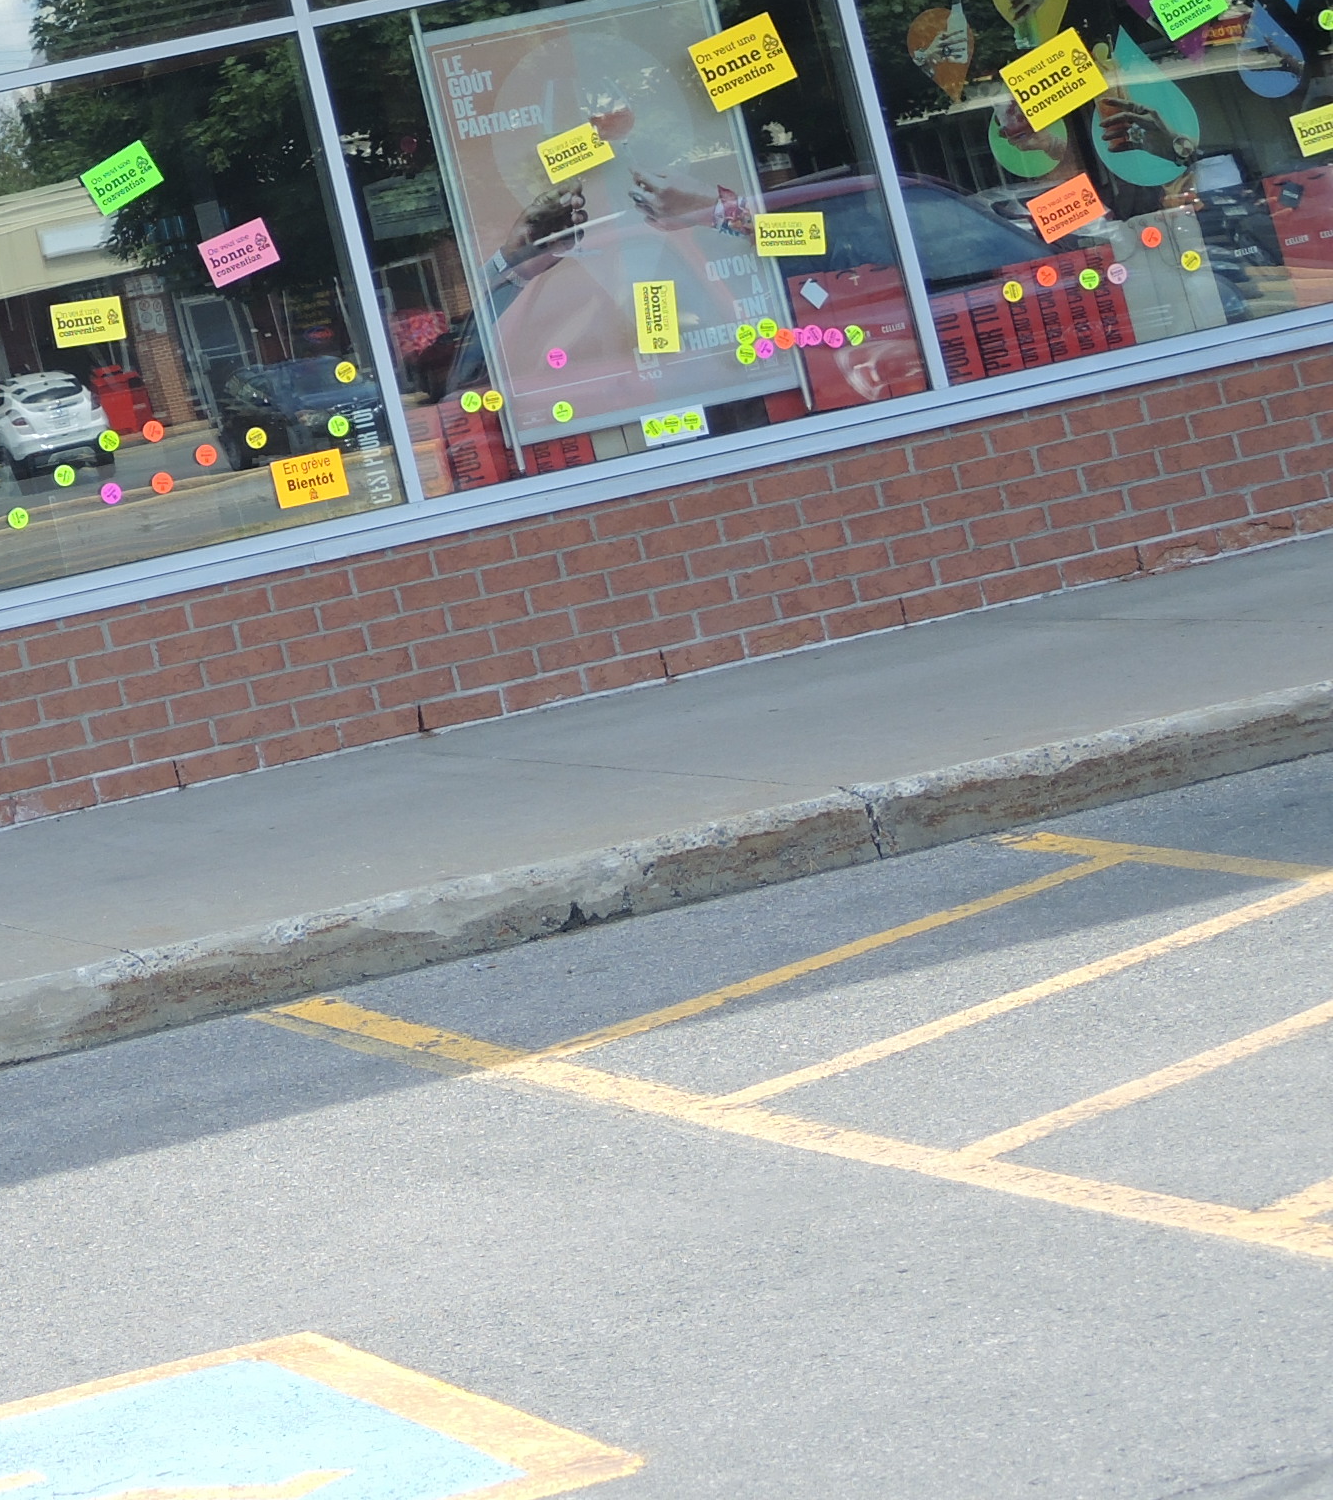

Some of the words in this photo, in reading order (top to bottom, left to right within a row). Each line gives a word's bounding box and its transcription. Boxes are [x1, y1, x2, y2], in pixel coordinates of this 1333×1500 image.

[1170, 4, 1212, 31] convention
[696, 53, 713, 65] On
[713, 42, 735, 57] veut
[737, 34, 756, 47] une
[766, 48, 784, 59] CSN
[442, 54, 465, 78] LE
[701, 48, 762, 83] bonne
[1008, 74, 1024, 86] On
[1024, 60, 1045, 76] veut
[1046, 50, 1065, 64] une
[1077, 61, 1093, 73] CSN
[448, 69, 493, 98] GOÛT
[710, 63, 775, 97] convention
[1015, 65, 1072, 103] bonne
[452, 96, 477, 119] DE
[1026, 77, 1086, 117] convention
[457, 104, 544, 140] PARTAGER
[1298, 121, 1333, 138] bonn
[544, 141, 588, 166] bonne
[94, 168, 136, 197] bonne
[103, 176, 145, 205] convention
[1039, 200, 1082, 226] bonne
[1046, 209, 1090, 234] convention
[759, 227, 803, 239] bonne
[210, 244, 254, 269] bonne
[217, 253, 262, 277] convention
[705, 254, 759, 282] QU'ON
[751, 275, 764, 294] A
[650, 285, 663, 332] bonne
[733, 295, 768, 321] FINI
[56, 314, 102, 330] bonne
[943, 336, 972, 378] POUR
[977, 327, 1011, 374] POUR
[357, 430, 384, 467] POUR
[450, 439, 485, 483] POUR
[283, 463, 299, 475] En
[301, 457, 331, 474] grève
[287, 472, 335, 491] Bientôt
[367, 469, 393, 504] C'EST
